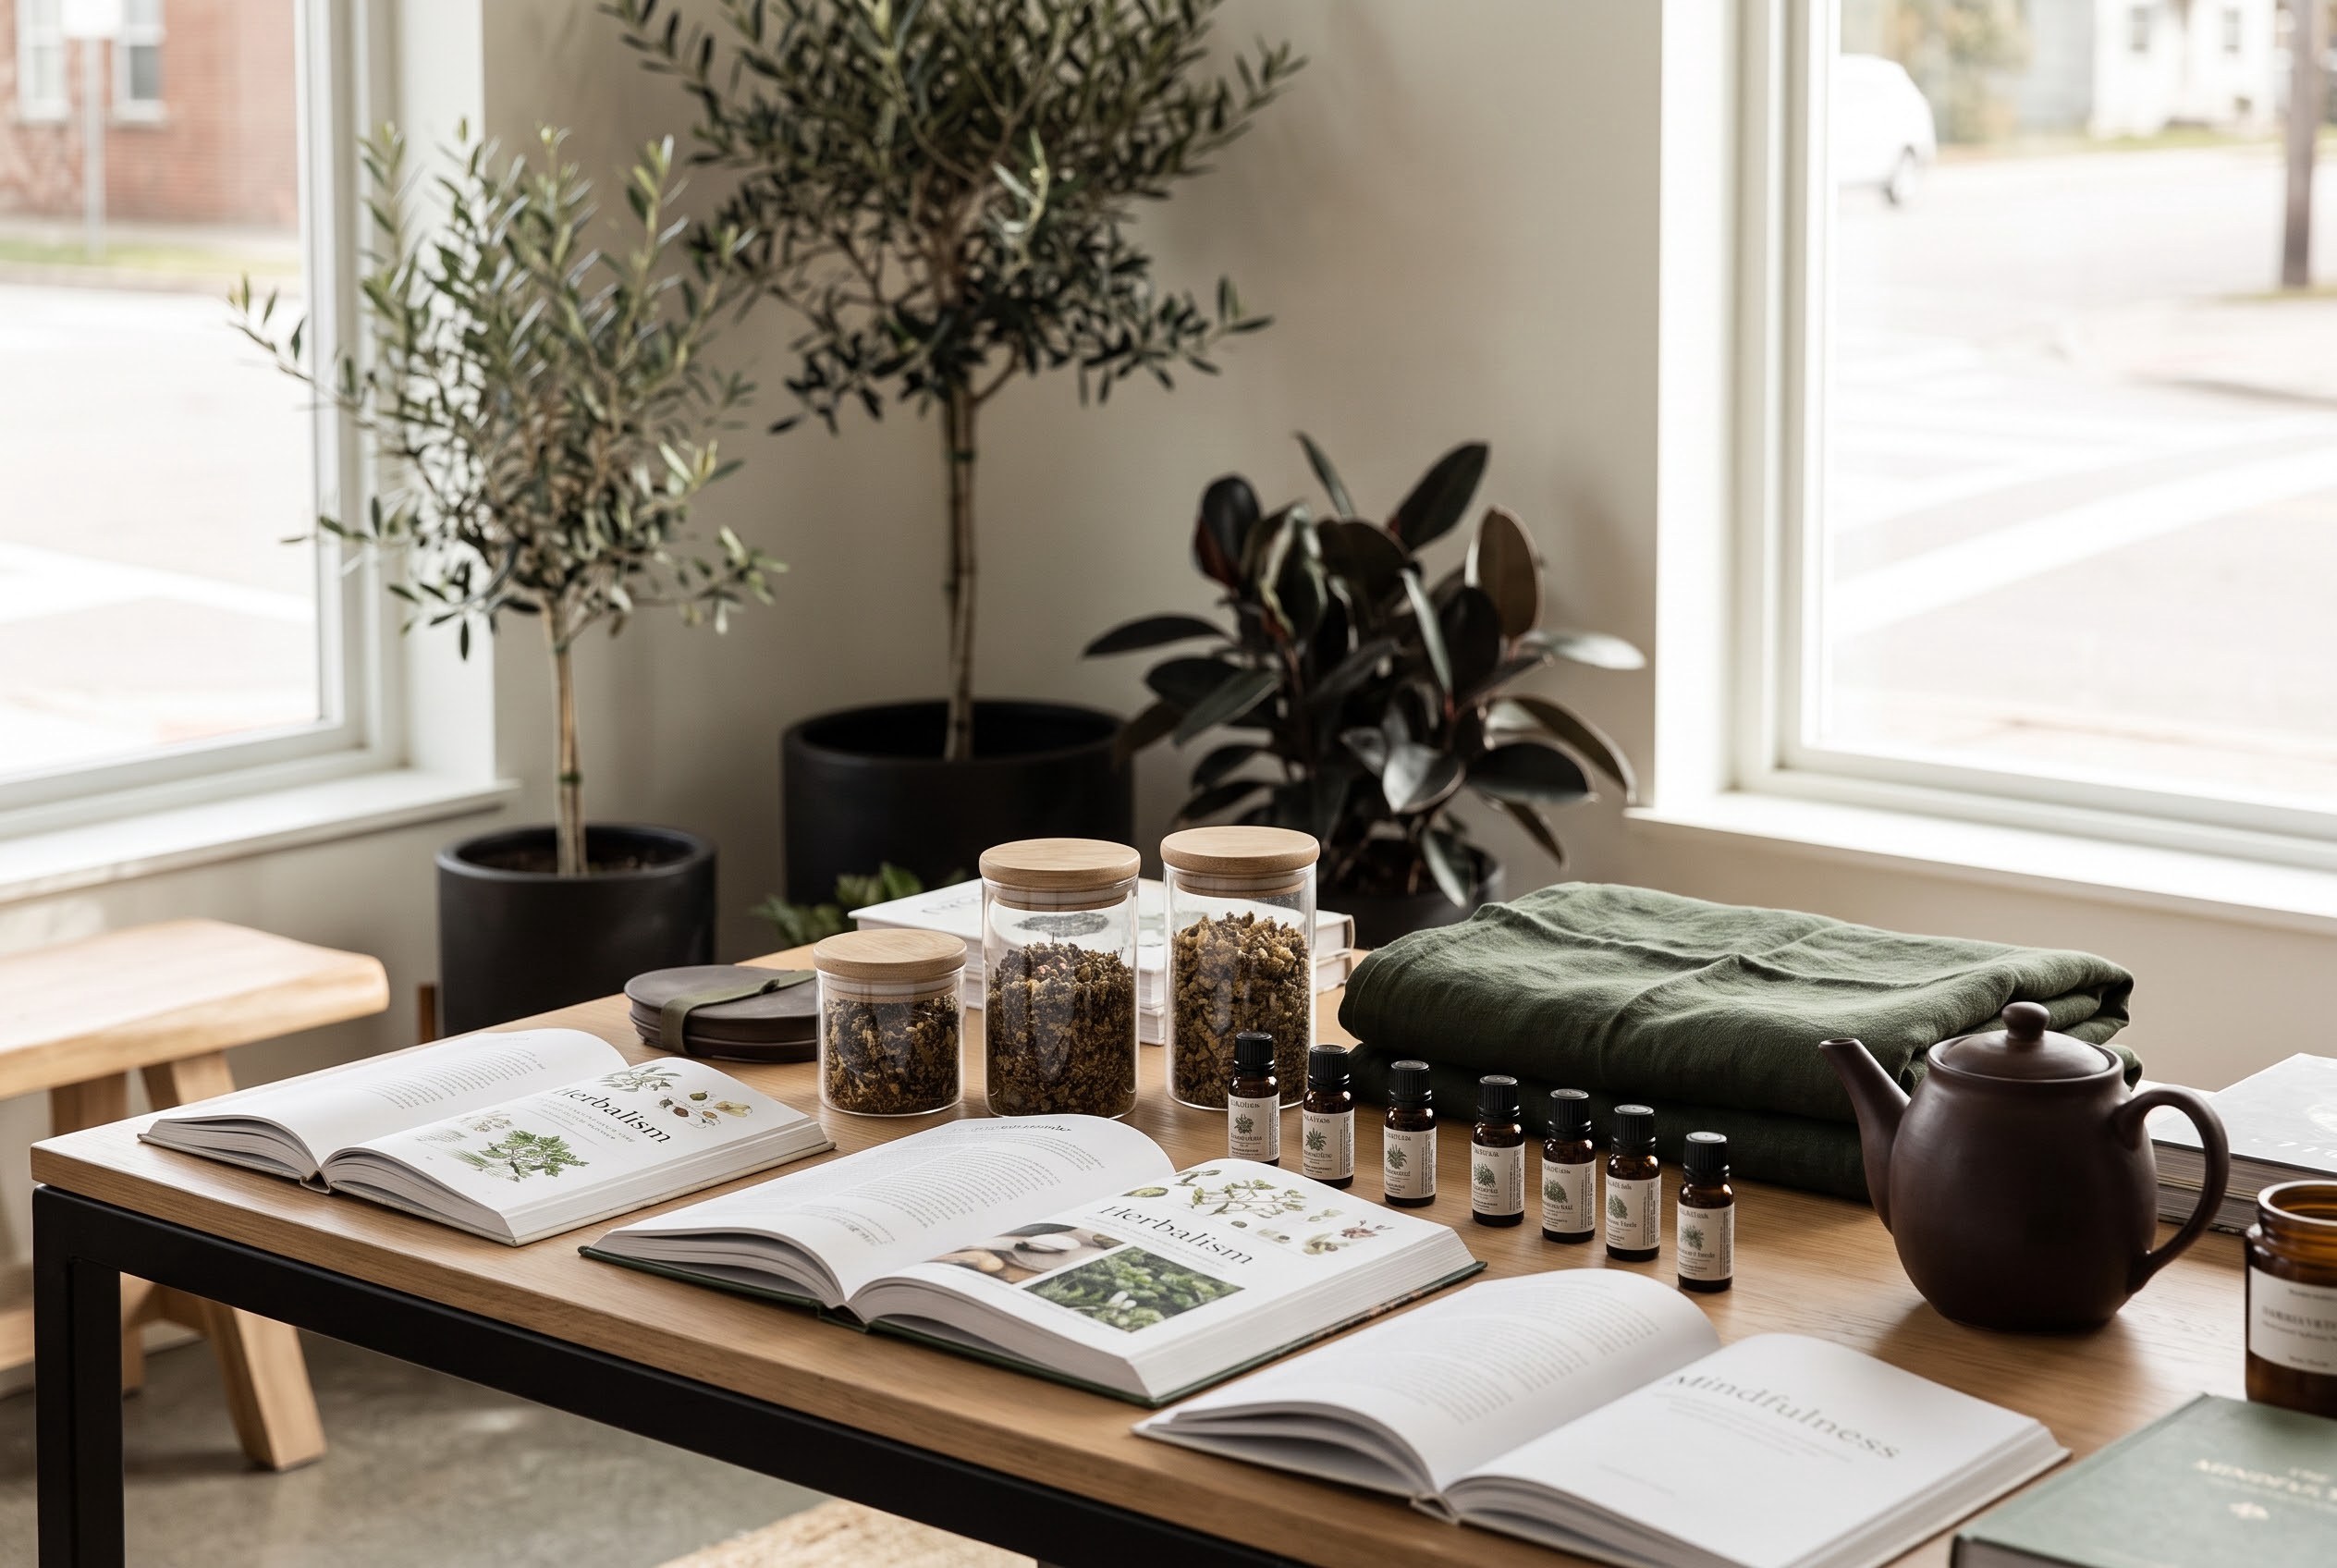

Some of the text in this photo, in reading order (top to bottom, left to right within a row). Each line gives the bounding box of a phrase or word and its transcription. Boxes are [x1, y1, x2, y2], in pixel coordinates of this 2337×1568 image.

[553, 1088, 671, 1143] Herbalism
[1097, 1206, 1253, 1264] Herbalism
[1669, 1375, 1900, 1458] Mindfulness
